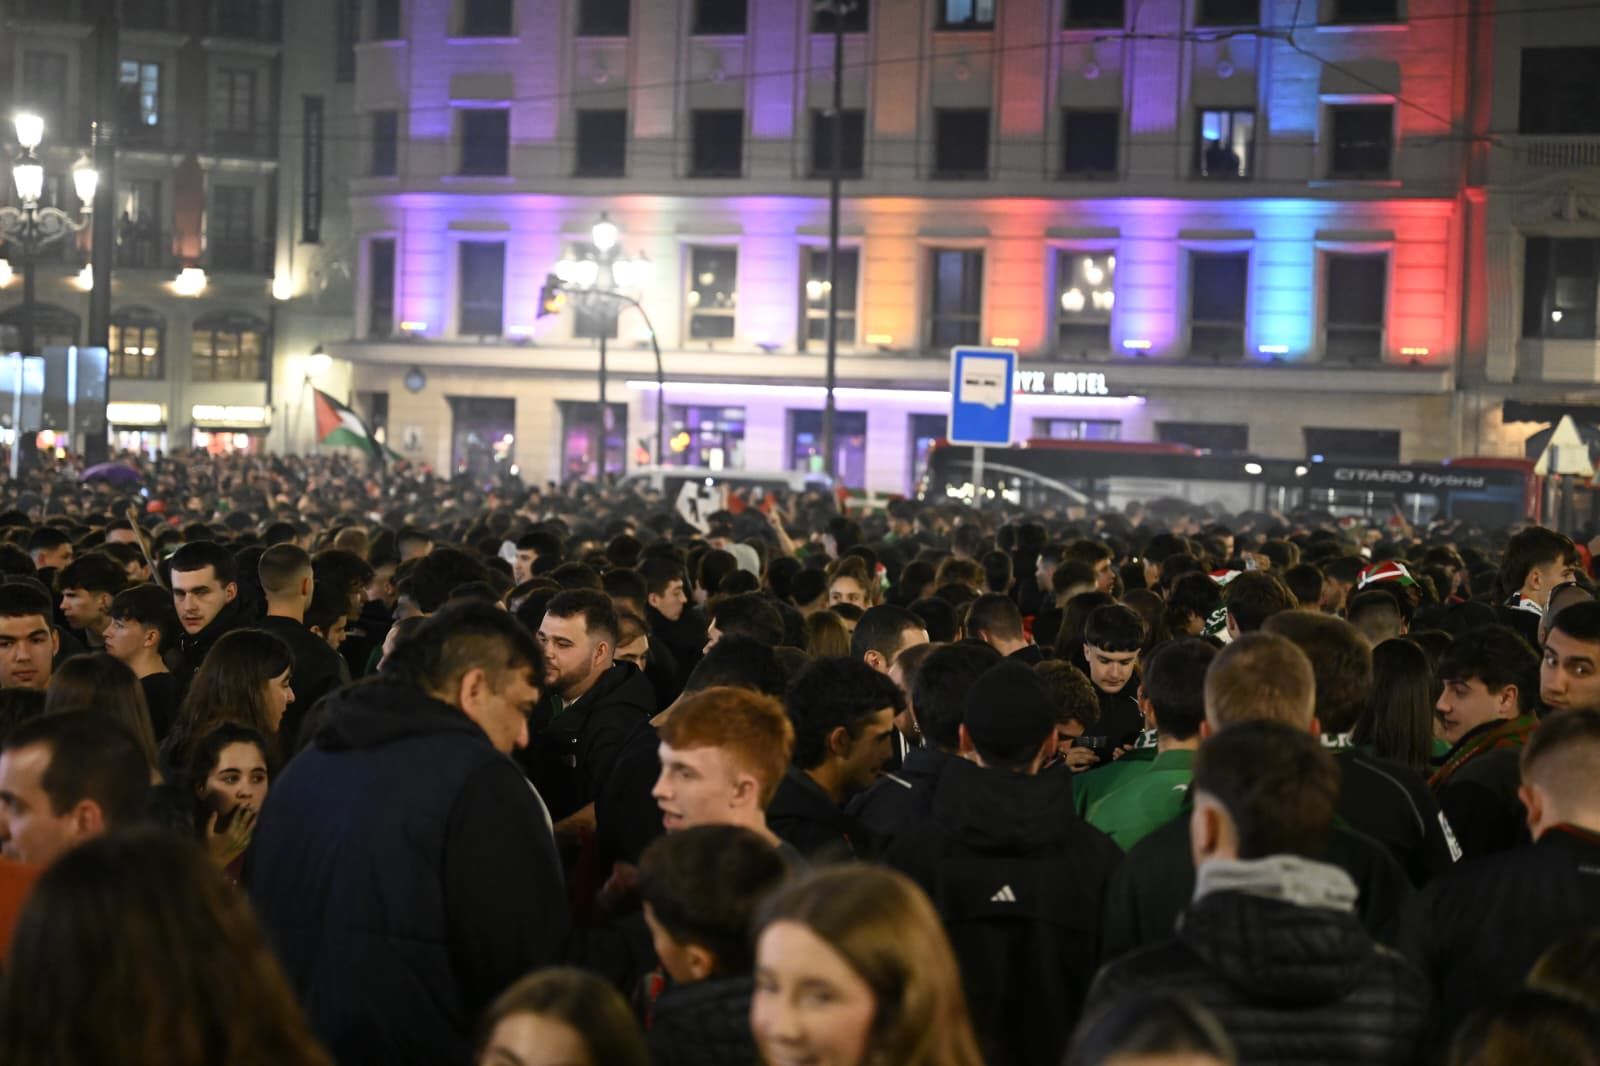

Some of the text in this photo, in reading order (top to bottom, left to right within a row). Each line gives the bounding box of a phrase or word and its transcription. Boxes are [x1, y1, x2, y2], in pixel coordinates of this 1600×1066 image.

[1053, 372, 1108, 394] HOTEL
[1334, 468, 1484, 487] CITARO hybrid
